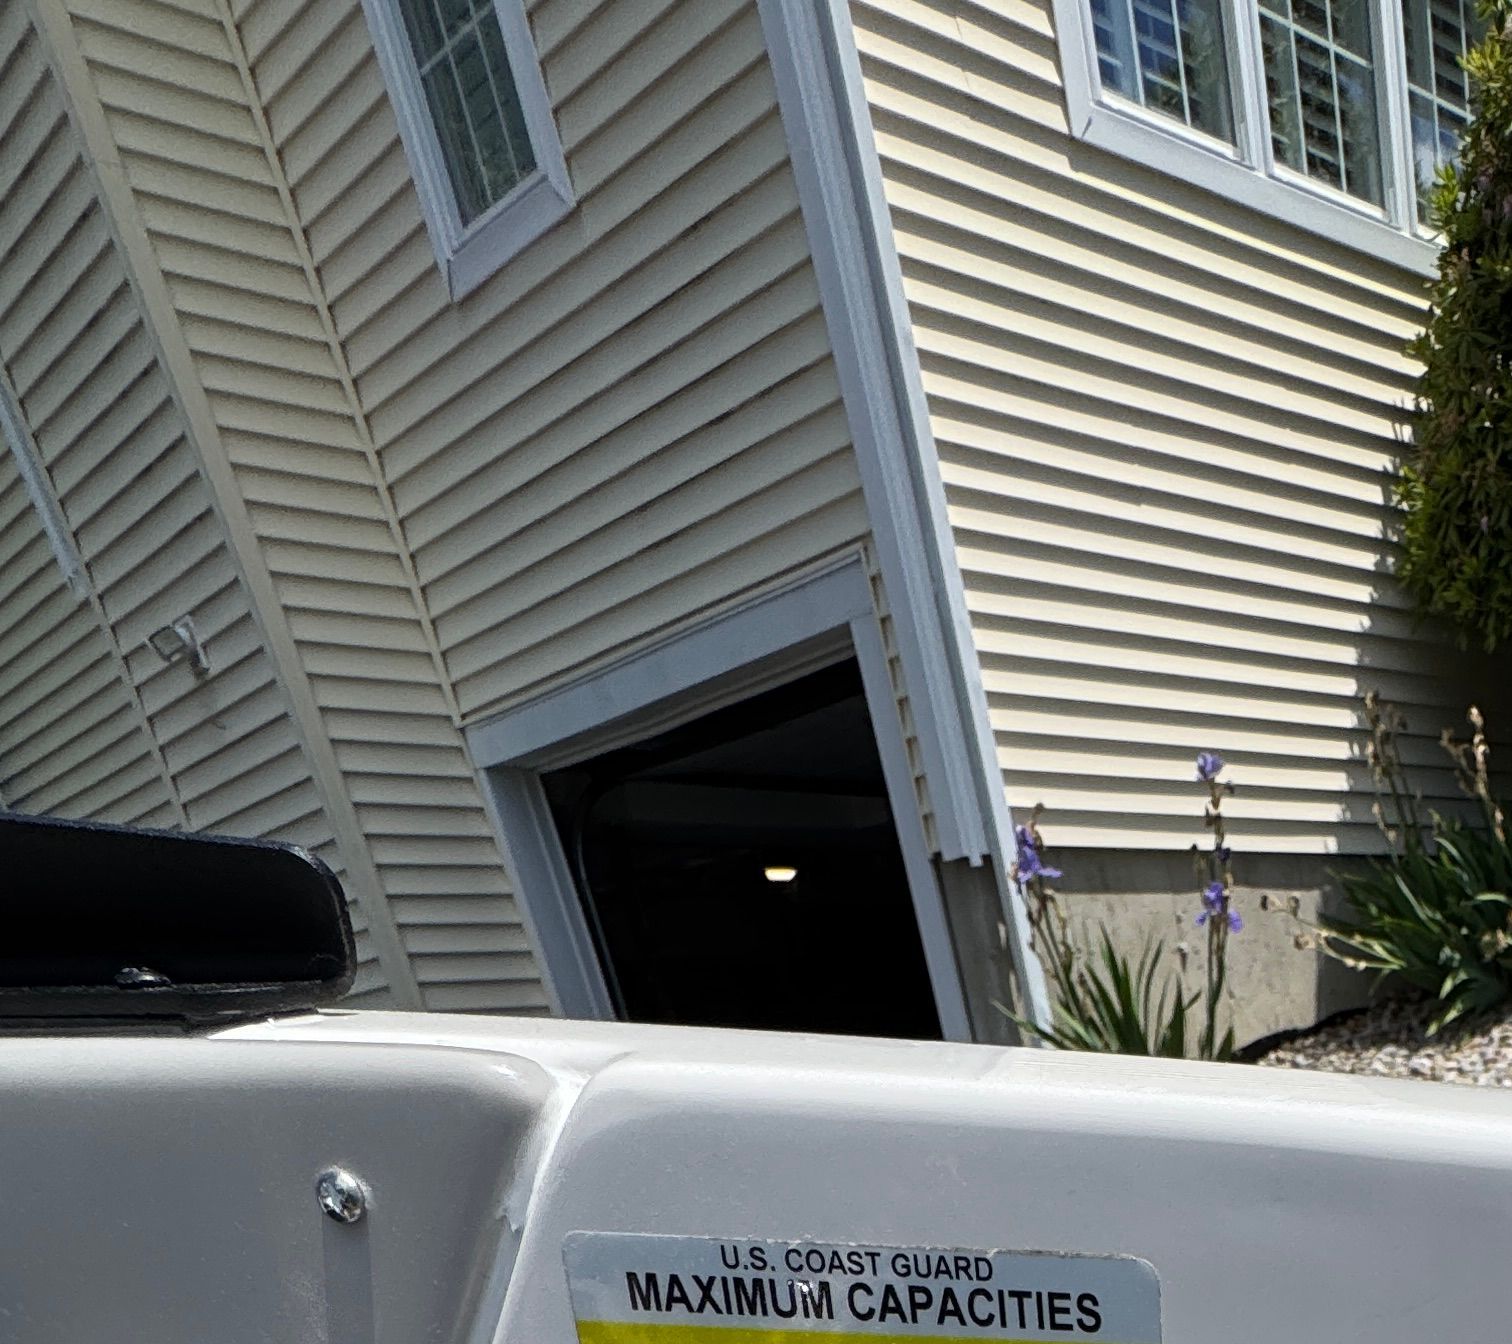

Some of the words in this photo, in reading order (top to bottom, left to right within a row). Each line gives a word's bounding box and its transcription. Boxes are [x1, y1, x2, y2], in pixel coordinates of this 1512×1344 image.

[720, 1244, 776, 1272] U.S.
[784, 1248, 881, 1277] COAST
[890, 1252, 994, 1282] GUARD
[625, 1271, 835, 1321] MAXIMUM
[846, 1281, 1102, 1333] CAPACITIES
